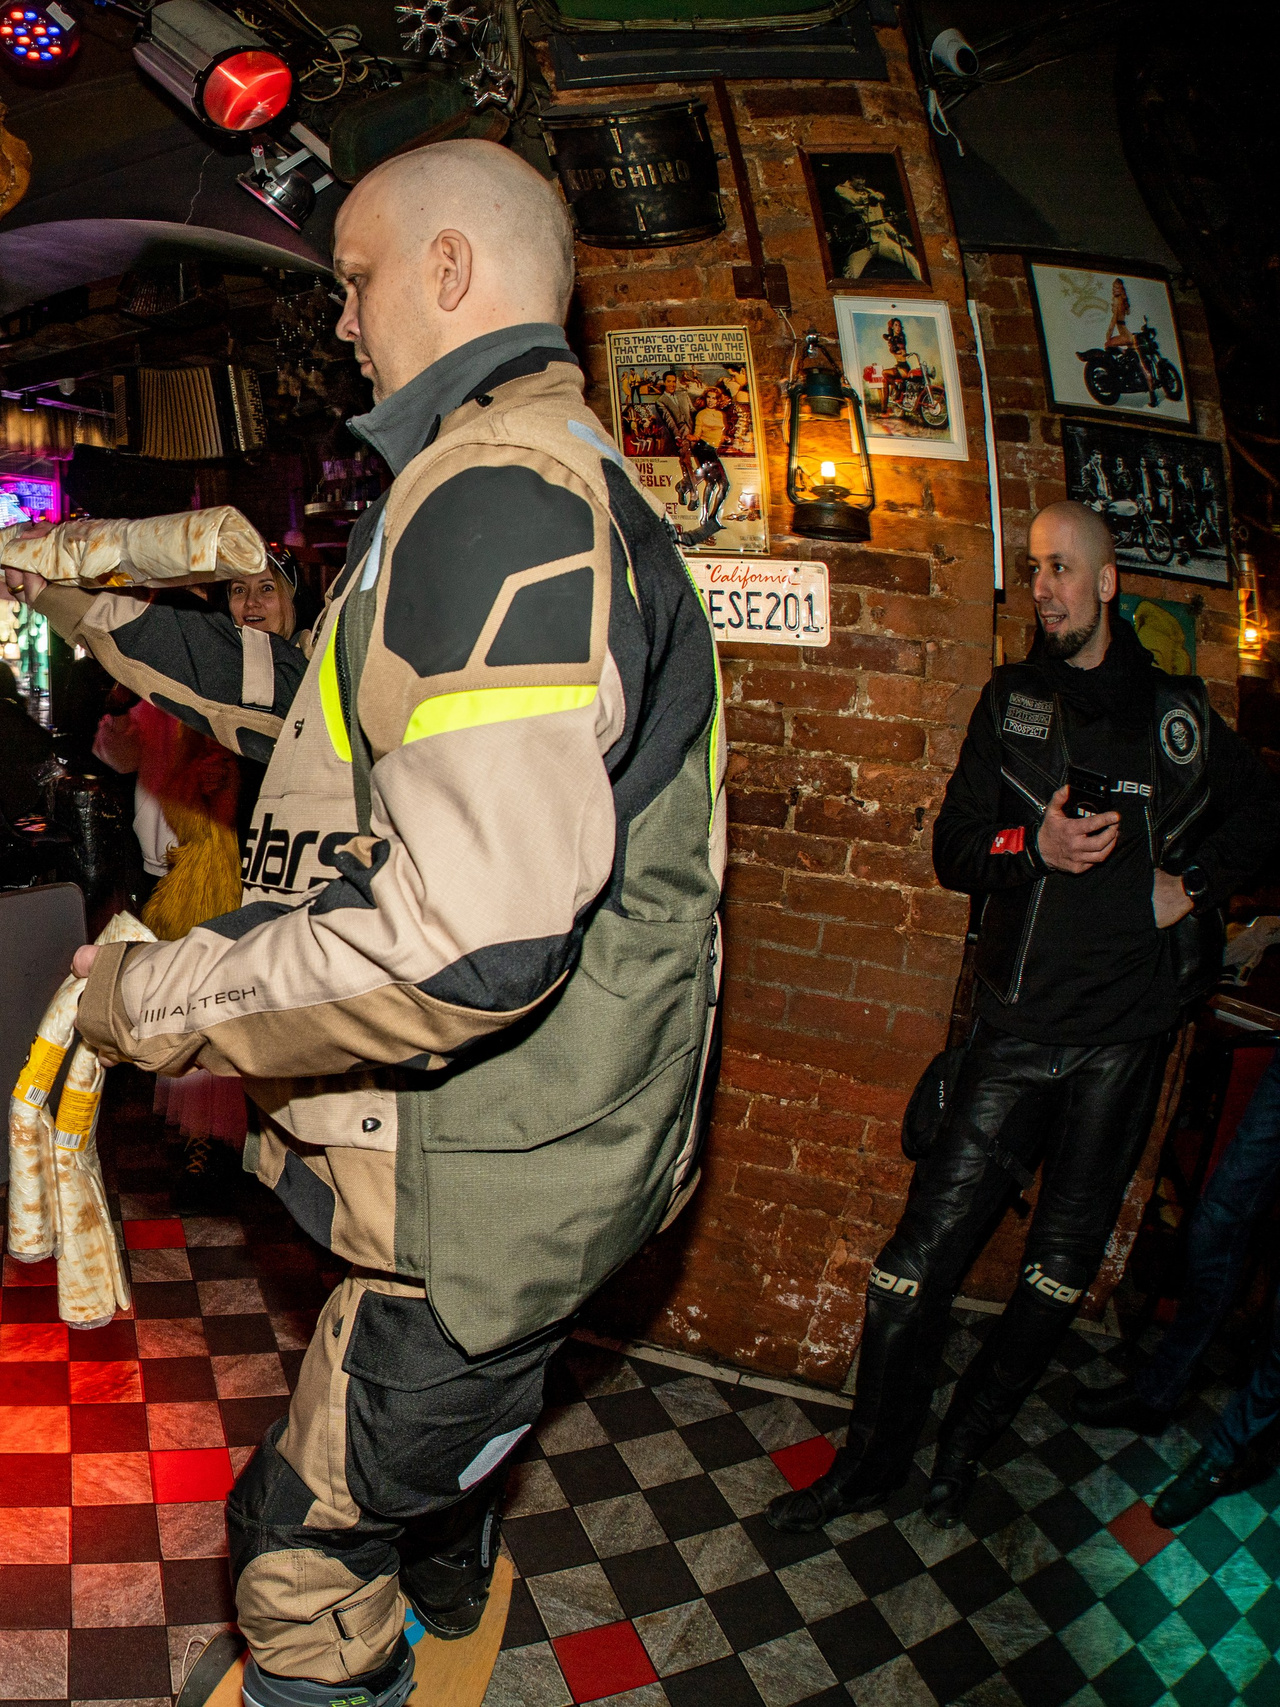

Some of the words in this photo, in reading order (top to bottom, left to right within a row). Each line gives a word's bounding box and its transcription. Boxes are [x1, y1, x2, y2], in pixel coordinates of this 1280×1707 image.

[613, 336, 630, 347] IT'S
[633, 335, 656, 345] THAT
[657, 333, 697, 344] "GO-GO"
[697, 333, 719, 342] GUY
[721, 332, 743, 342] AND
[614, 346, 639, 355] THAT
[639, 344, 689, 353] "BYE-BYE"
[690, 343, 710, 352] GAL
[711, 343, 722, 352] IN
[725, 342, 745, 351] THE
[615, 355, 633, 364] FUN
[636, 353, 673, 363] CAPITAL
[674, 353, 686, 362] OF
[687, 352, 705, 362] THE
[707, 352, 746, 361] WORLD!
[635, 462, 654, 475] VIS
[640, 474, 672, 487] ESLEY
[710, 564, 801, 590] California
[698, 588, 821, 634] ESE201
[1008, 719, 1042, 737] PROSPECT
